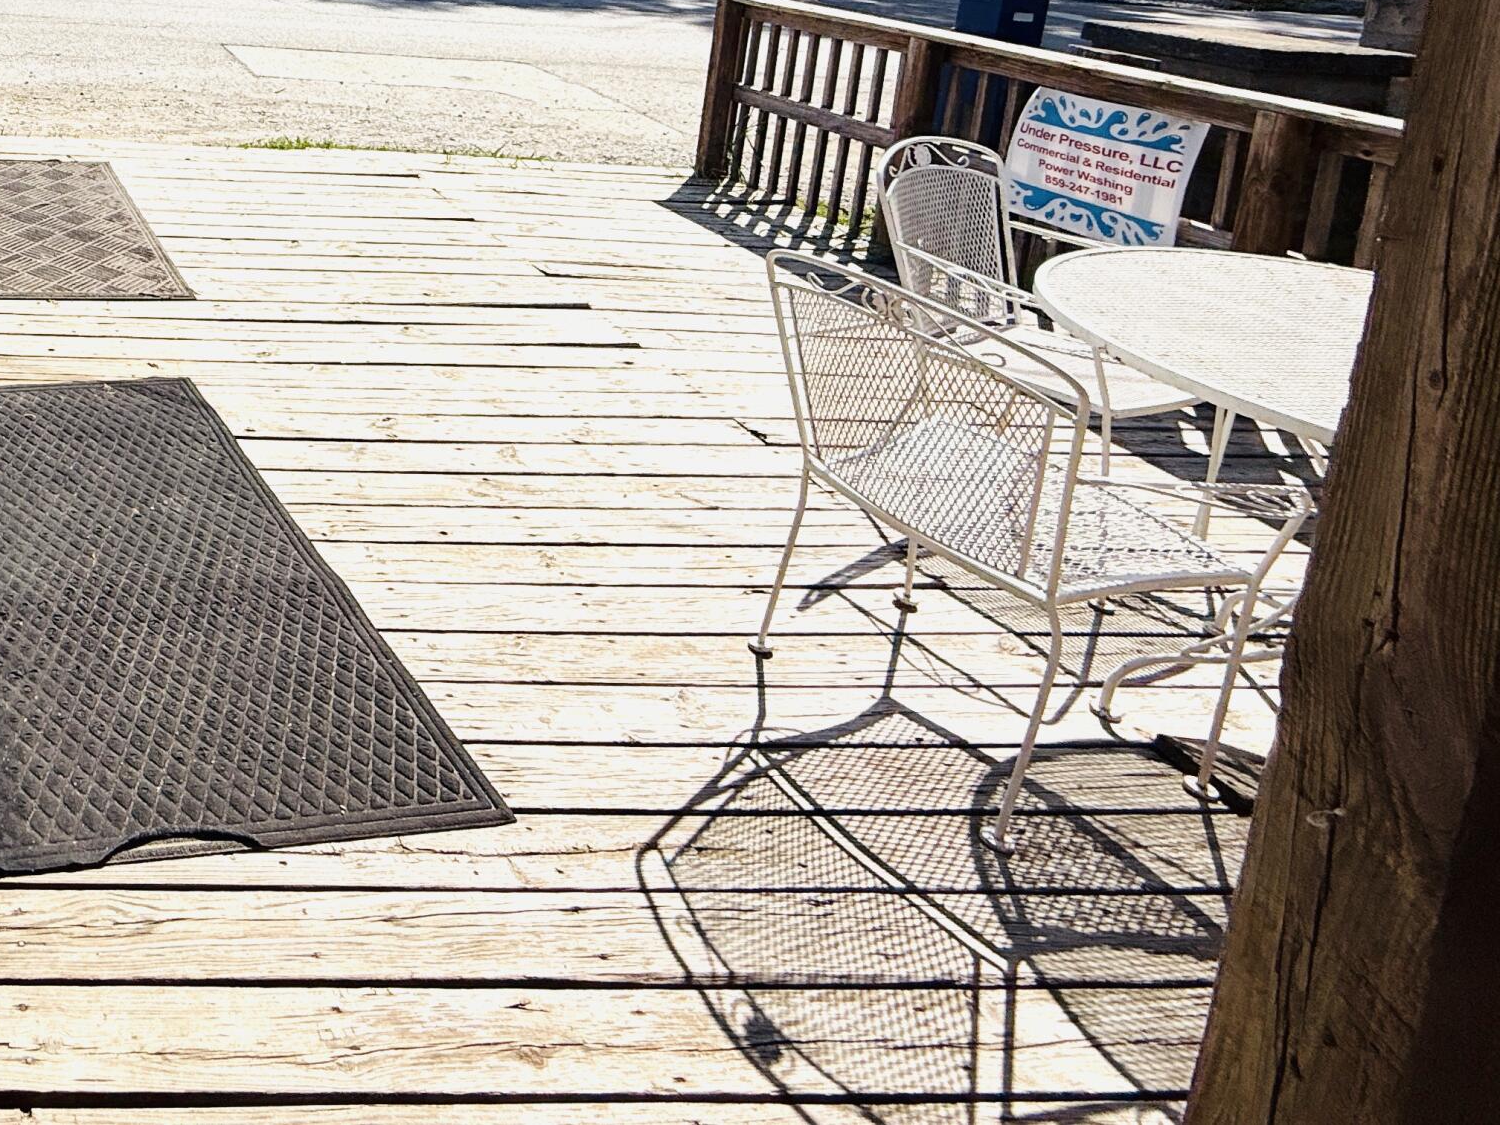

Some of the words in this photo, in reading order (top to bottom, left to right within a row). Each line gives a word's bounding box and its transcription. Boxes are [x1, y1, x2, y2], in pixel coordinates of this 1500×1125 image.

[1017, 138, 1080, 164] Commercial
[1082, 157, 1092, 167] &
[1095, 160, 1176, 189] Residential
[1020, 122, 1056, 142] Under
[1059, 133, 1133, 165] Pressure,
[1140, 153, 1184, 173] LLC
[1038, 158, 1075, 176] Power
[1077, 169, 1133, 196] Washing
[1045, 175, 1123, 205] 859-247-1981
